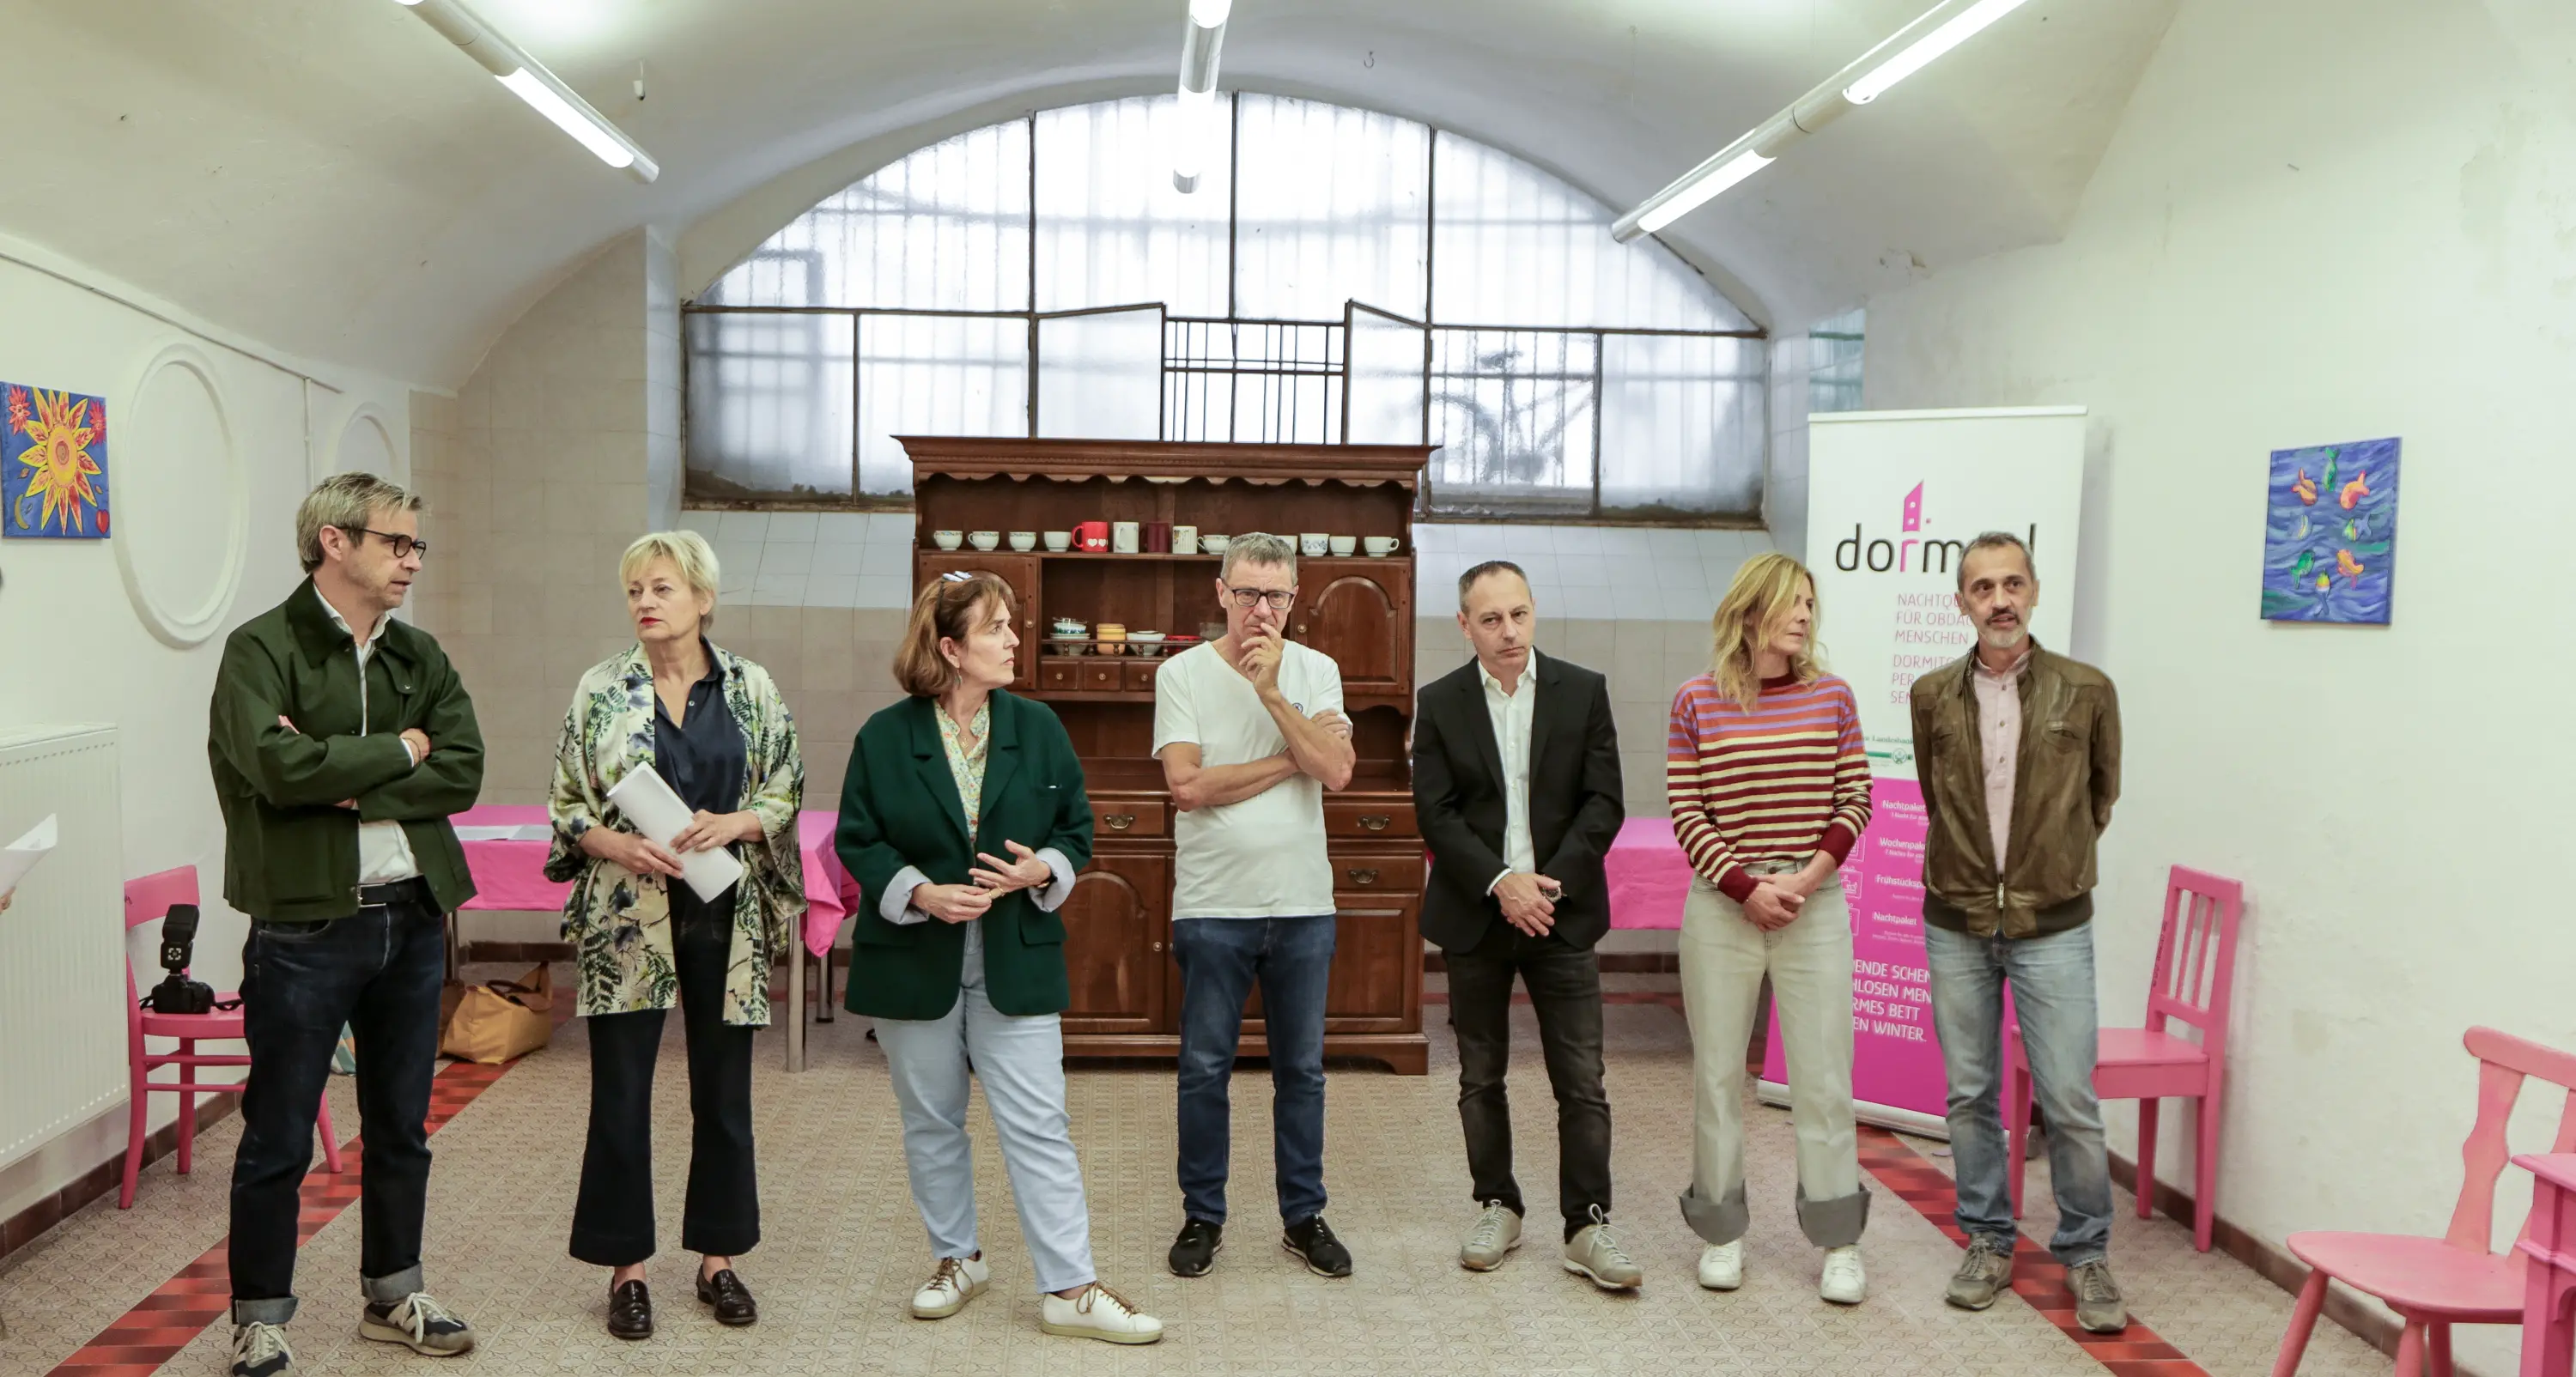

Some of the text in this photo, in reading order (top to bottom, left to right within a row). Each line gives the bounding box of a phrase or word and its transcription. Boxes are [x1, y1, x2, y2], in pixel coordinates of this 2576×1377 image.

[1836, 523, 2037, 573] dorml
[1896, 609, 1922, 625] FÜR
[1895, 629, 1970, 645] MENSCHEN
[1892, 672, 1915, 686] PER
[1882, 799, 1927, 813] Nachtpaket
[1874, 912, 1917, 926] Nachtpaket
[1854, 959, 1888, 977] ENDE
[1889, 1003, 1921, 1021] BETT
[1874, 1020, 1927, 1042] WINTER.
